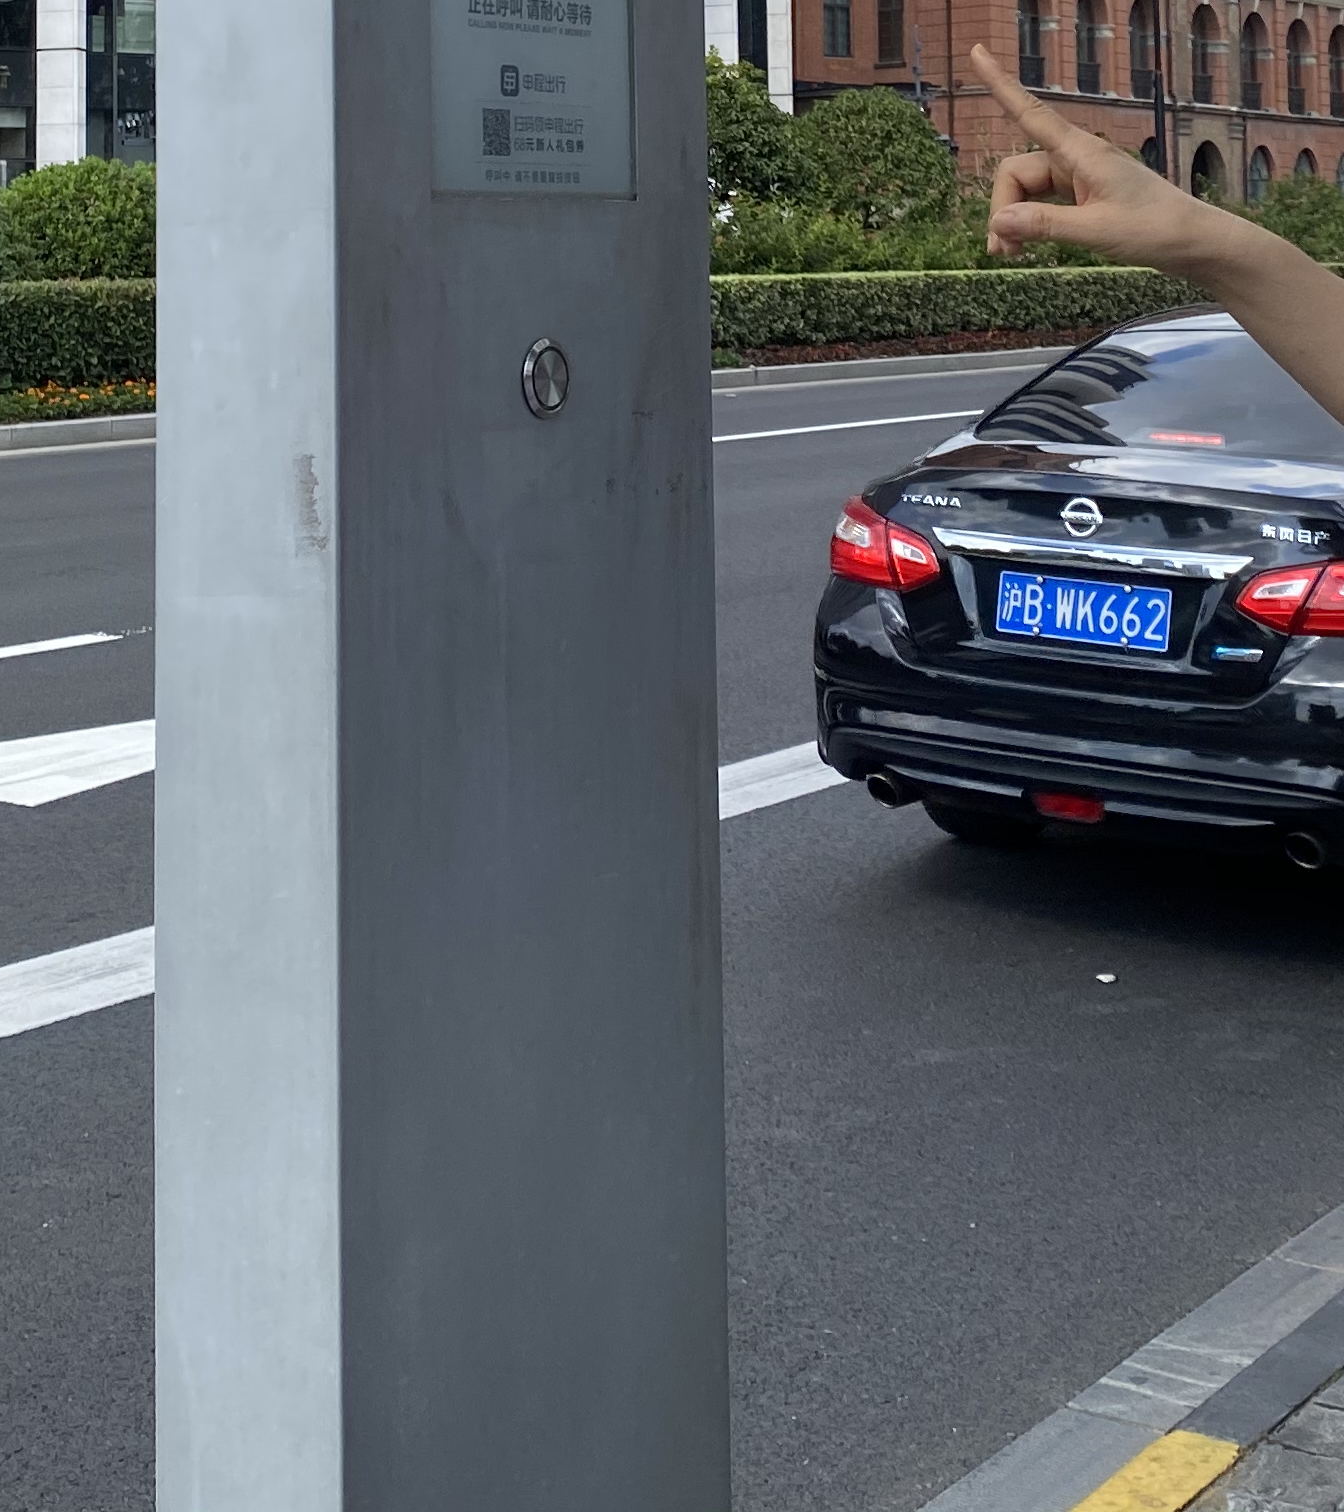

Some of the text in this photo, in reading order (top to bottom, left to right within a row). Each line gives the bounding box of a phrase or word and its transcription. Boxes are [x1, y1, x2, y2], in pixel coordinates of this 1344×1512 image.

[901, 493, 962, 508] TEANA
[1260, 524, 1331, 545] 东风日产
